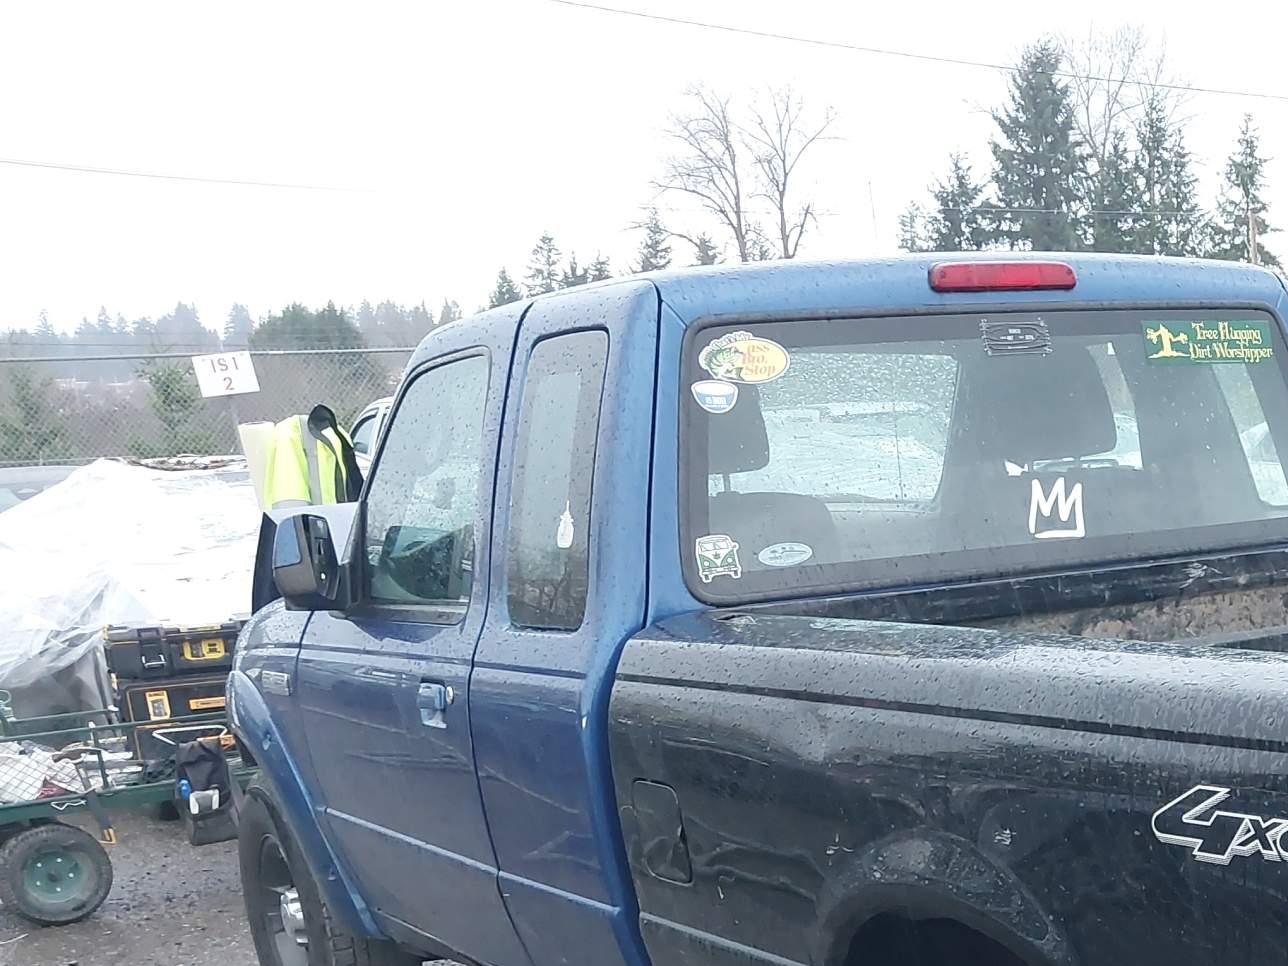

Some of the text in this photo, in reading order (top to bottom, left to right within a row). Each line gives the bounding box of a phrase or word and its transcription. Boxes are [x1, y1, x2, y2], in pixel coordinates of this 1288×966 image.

[1192, 322, 1262, 345] Tree Hugging
[1189, 342, 1212, 359] Dirt
[223, 377, 235, 391] 2
